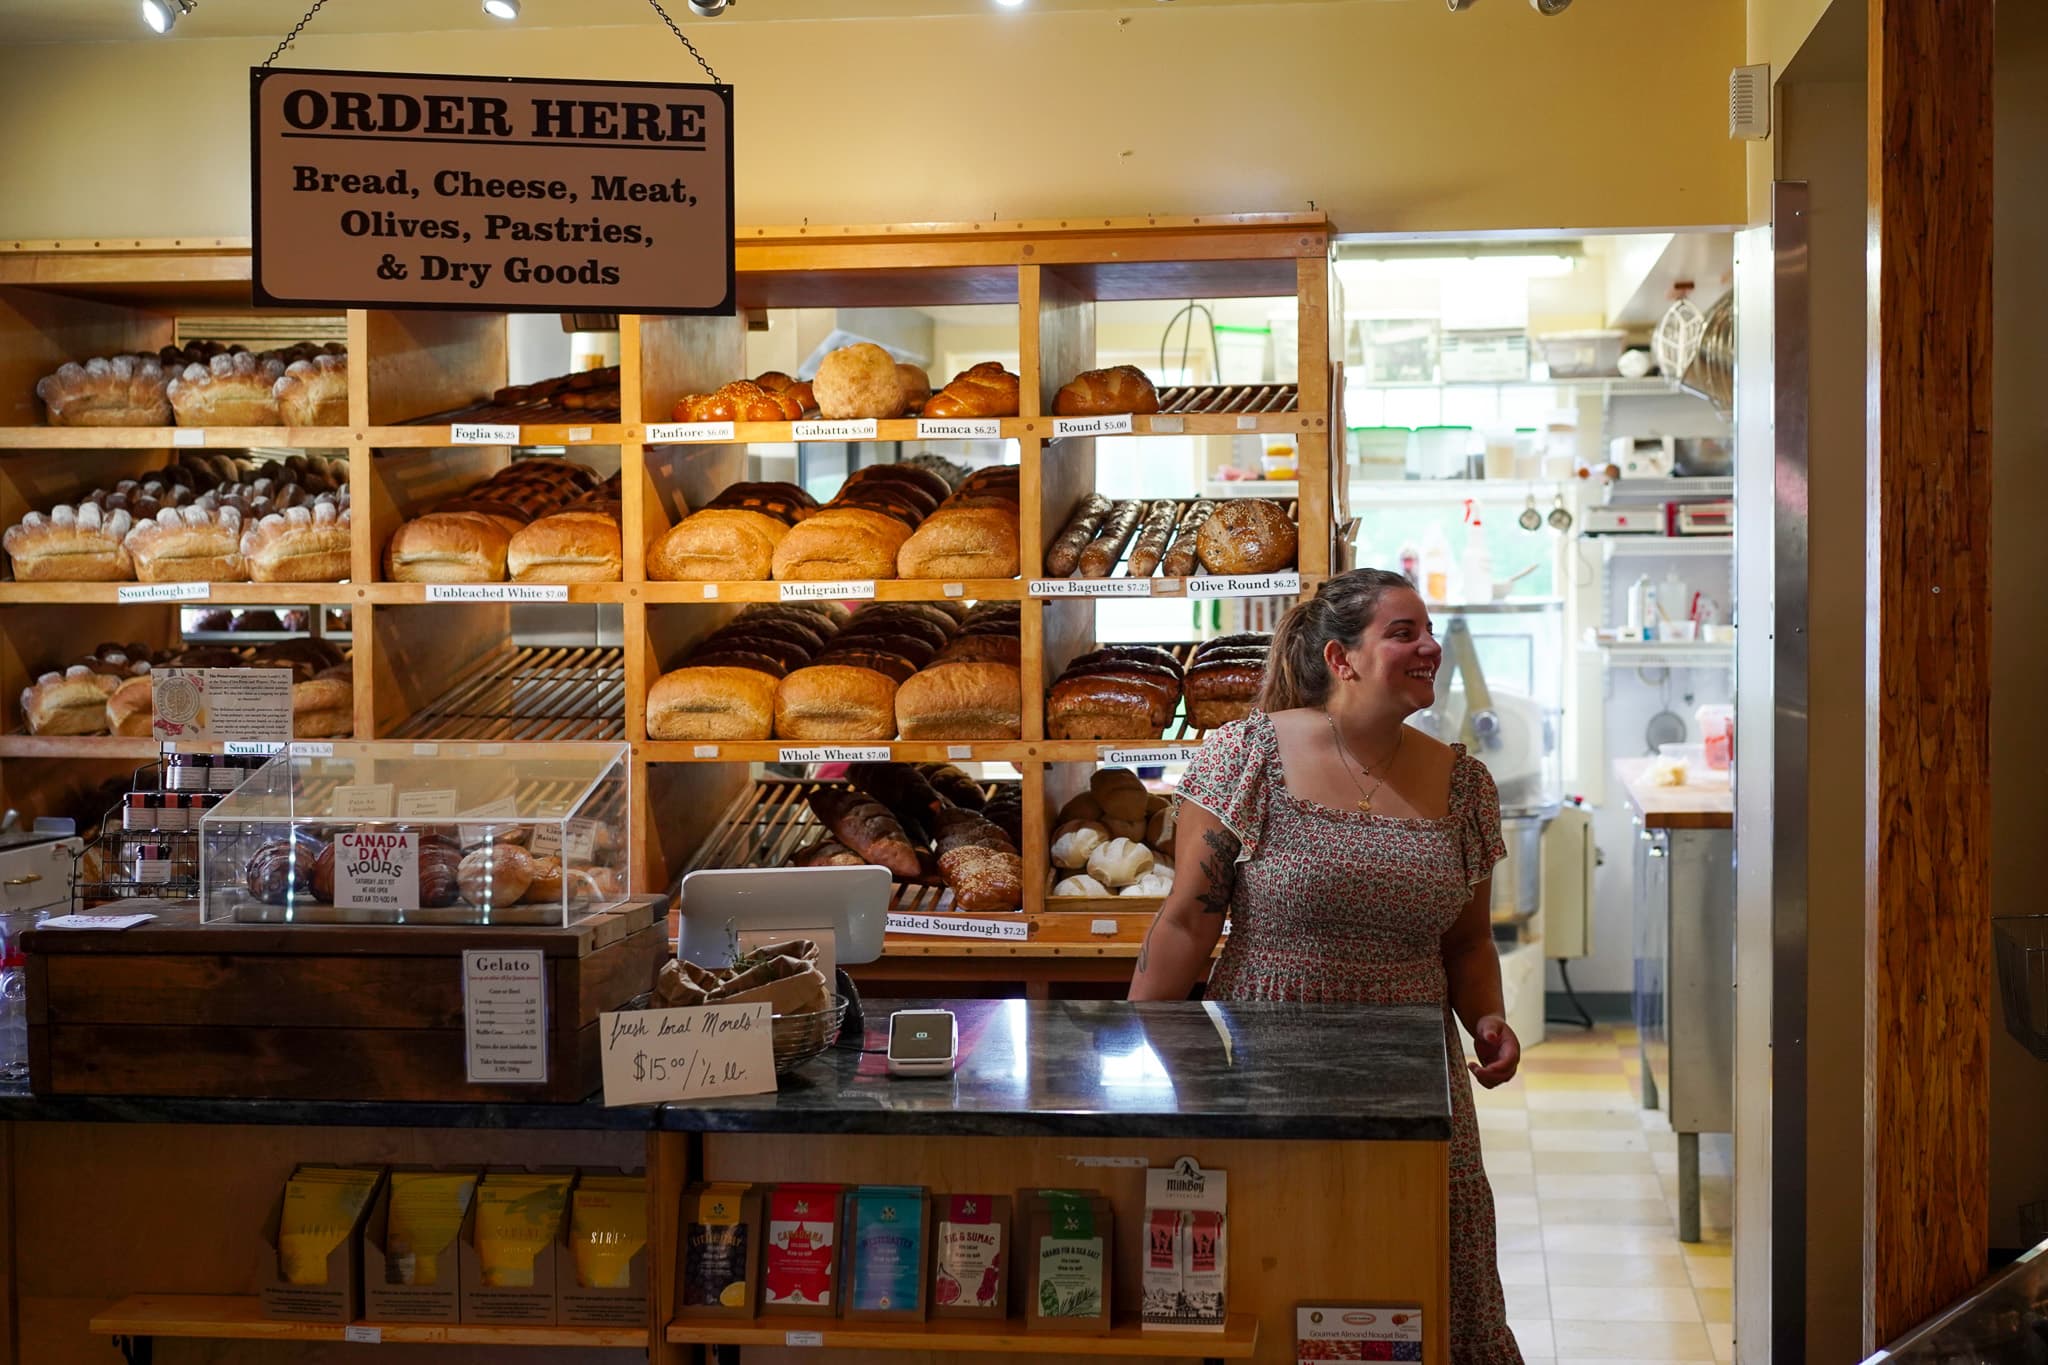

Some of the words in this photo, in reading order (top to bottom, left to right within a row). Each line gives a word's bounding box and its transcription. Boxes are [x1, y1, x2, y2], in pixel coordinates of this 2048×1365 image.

[282, 89, 513, 137] ORDER
[531, 99, 706, 143] HERE
[292, 165, 421, 199] Bread,
[433, 170, 578, 203] Cheese,
[590, 175, 698, 207] Meat,
[340, 210, 472, 243] Olives,
[484, 214, 654, 247] Pastries,
[376, 254, 408, 281] &
[420, 255, 491, 288] Dry
[504, 258, 620, 285] Goods
[652, 427, 704, 438] Panfiore
[795, 425, 848, 436] Ciabatta
[920, 423, 971, 434] Lumaca
[974, 426, 997, 434] $6.25
[1059, 420, 1101, 433] Round
[1104, 421, 1127, 430] $5.00
[455, 427, 491, 441] Foglia
[494, 431, 516, 439] $6.25
[119, 585, 184, 599] Sourdough
[782, 584, 849, 597] Multigrain
[851, 585, 873, 594] $7.00
[1030, 582, 1065, 593] Olive
[1068, 581, 1124, 594] Baguette
[1126, 583, 1149, 592] $7.25
[1189, 580, 1224, 592] Olive
[1227, 578, 1270, 590] Round
[1273, 579, 1297, 588] $6.25
[432, 587, 504, 598] Unbleached
[507, 587, 542, 598] White
[545, 589, 567, 598] $7.00
[228, 743, 264, 754] Small
[781, 750, 821, 761] Whole
[824, 749, 863, 760] Wheat
[866, 751, 889, 760] $7.00
[1110, 752, 1177, 763] Cinnamon
[342, 834, 408, 848] CANADA
[359, 847, 391, 861] DAY
[346, 860, 403, 878] HOURS
[932, 918, 1000, 936] Sourdough
[1003, 927, 1026, 936] $7.25
[476, 957, 530, 971] Gelato
[609, 1013, 649, 1051] fresh
[657, 1016, 692, 1037] local
[1166, 1179, 1205, 1193] MilkBoy
[967, 1232, 995, 1245] SUMAC
[1310, 1330, 1340, 1338] Gourmet
[1341, 1330, 1367, 1338] Almond
[1368, 1331, 1393, 1340] Nougat
[1394, 1332, 1409, 1340] Bars
